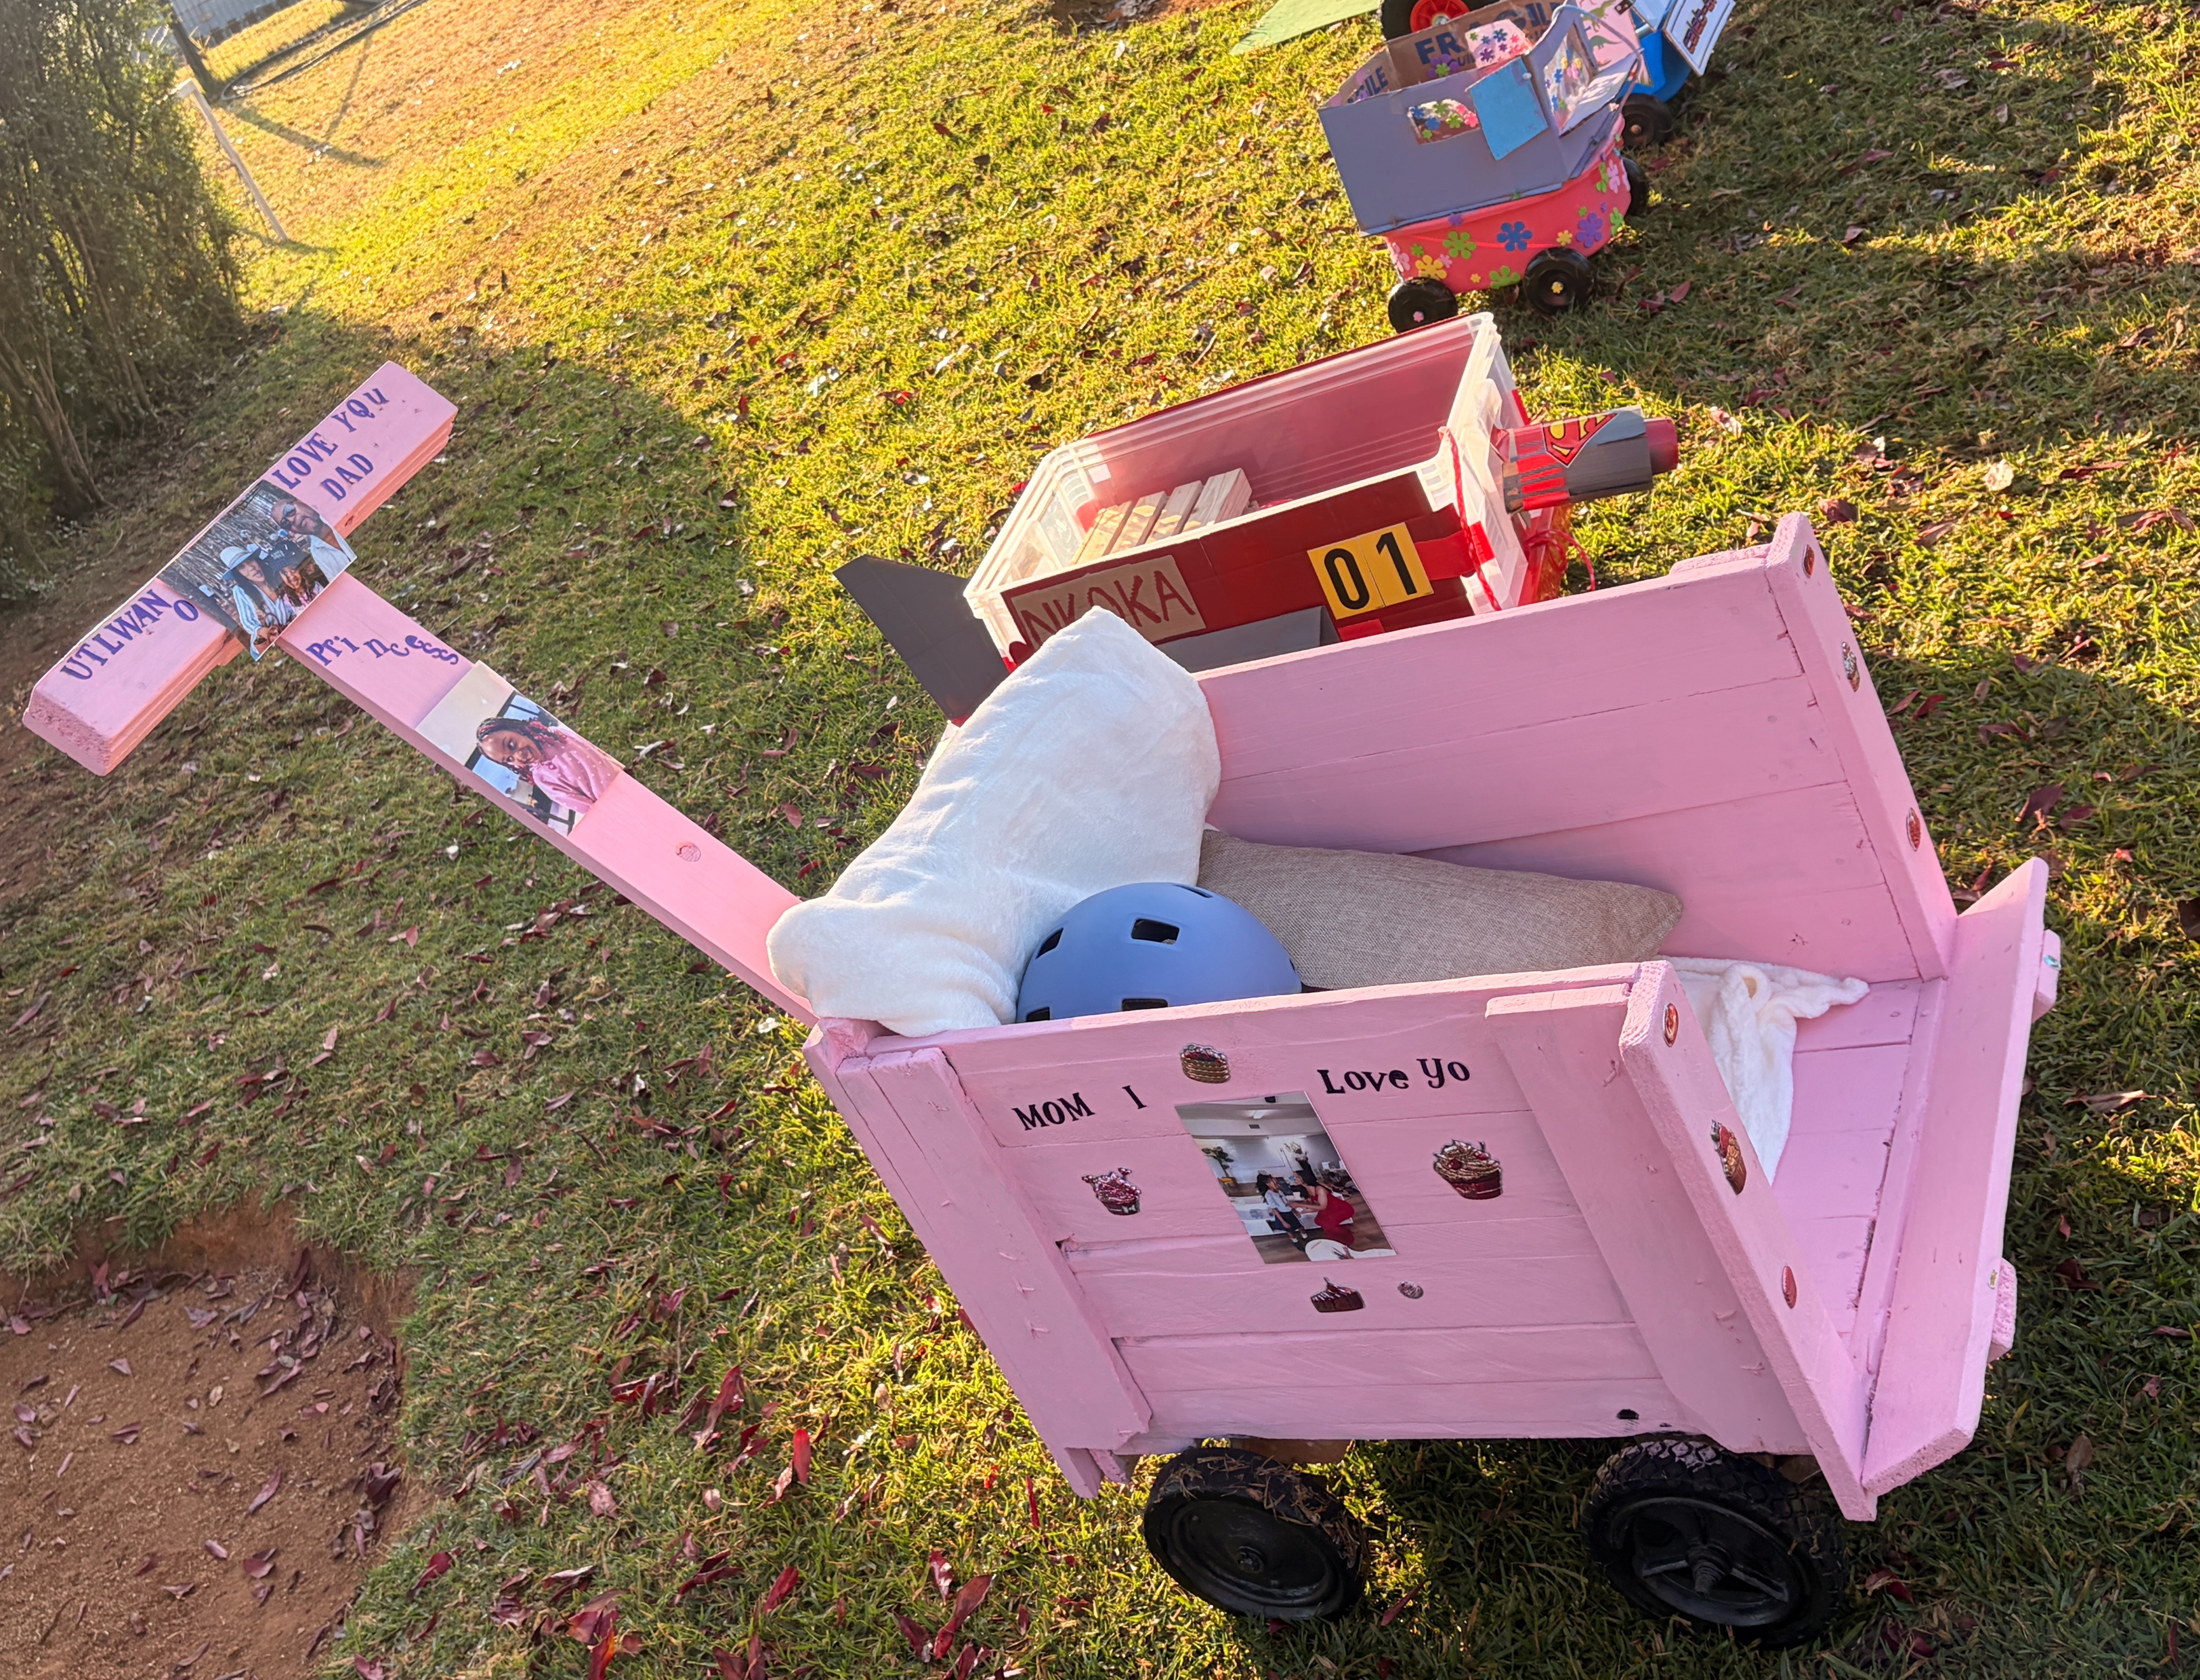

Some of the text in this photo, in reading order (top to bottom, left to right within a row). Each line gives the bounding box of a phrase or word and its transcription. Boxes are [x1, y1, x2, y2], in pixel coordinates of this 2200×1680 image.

[272, 432, 338, 490] LOVE
[320, 453, 374, 501] DAD
[1324, 532, 1418, 610] 01
[1011, 1092, 1096, 1131] MOM
[1122, 1085, 1148, 1109] I
[1317, 1069, 1409, 1094] Love
